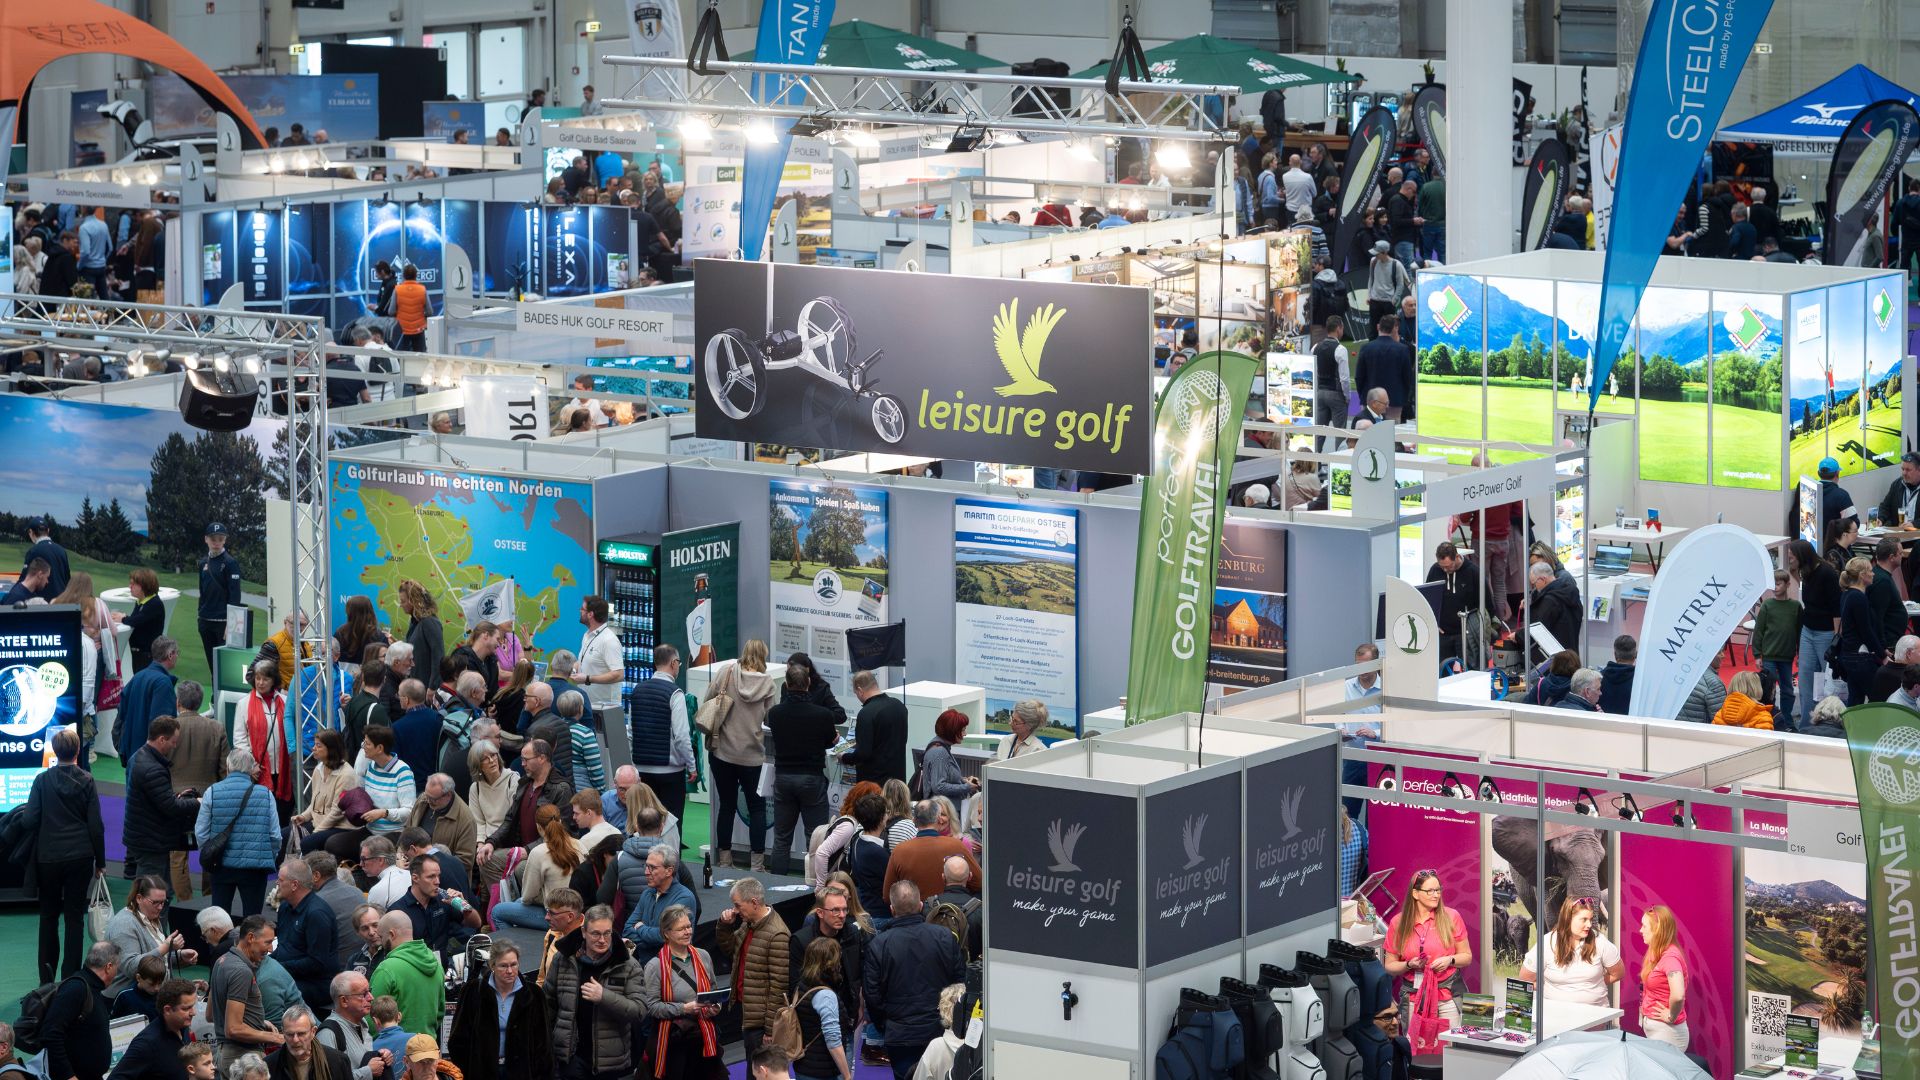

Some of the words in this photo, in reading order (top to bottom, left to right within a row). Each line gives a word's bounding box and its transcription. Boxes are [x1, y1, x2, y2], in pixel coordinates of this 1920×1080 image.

[1724, 29, 1734, 42] by
[1719, 44, 1731, 69] made
[1258, 73, 1312, 86] HOLSTEN
[559, 133, 573, 143] Golf
[576, 135, 592, 145] Club
[594, 135, 608, 145] Bad
[609, 136, 637, 145] Saarow
[794, 147, 820, 156] POLEN
[718, 170, 735, 179] Golf
[1863, 121, 1911, 211] www.private-greens.de
[705, 200, 724, 210] GOLF
[525, 312, 558, 325] BADES
[562, 316, 583, 327] HUK
[587, 317, 616, 330] GOLF
[619, 319, 663, 333] RESORT
[918, 389, 1049, 439] leisure
[1055, 403, 1133, 454] golf
[347, 464, 426, 486] Golfurlaub
[430, 471, 448, 487] im
[452, 475, 504, 493] echten
[509, 480, 563, 499] Norden
[1463, 481, 1504, 501] PG-Power
[1505, 475, 1522, 494] Golf
[775, 493, 810, 504] Ankommen
[815, 497, 839, 507] Spielen
[843, 500, 860, 510] Spaß
[860, 502, 880, 512] haben
[1157, 441, 1186, 566] perfect
[964, 511, 996, 521] MARITIM
[997, 514, 1036, 525] GOLFPARK
[1037, 518, 1067, 529] OSTSEE
[494, 538, 527, 551] OSTSEE
[670, 540, 731, 568] HOLSTEN
[618, 550, 647, 561] HOLSTEN
[1171, 459, 1221, 661] GOLFTRAVEL
[1659, 574, 1728, 663] MATRIX
[30, 635, 62, 646] TIME
[1673, 640, 1704, 686] GOLF
[1706, 577, 1754, 637] REISEN
[26, 650, 68, 658] MESSEPARTY
[40, 674, 65, 685] 18:00
[1207, 670, 1271, 684] el-breitenburg.de
[1750, 821, 1760, 830] La
[1256, 842, 1298, 870] leisure
[1300, 827, 1326, 860] golf
[1790, 844, 1806, 854] C16
[1836, 832, 1862, 847] Golf
[1007, 865, 1076, 895] leisure
[1080, 876, 1122, 906] golf
[1156, 872, 1202, 900] leisure
[1203, 856, 1231, 891] golf
[1259, 872, 1281, 889] make
[1280, 869, 1300, 897] your
[1302, 861, 1324, 884] game
[1013, 898, 1047, 912] make
[1044, 904, 1078, 928] your
[1080, 908, 1116, 928] game
[1160, 904, 1182, 920] make
[1182, 898, 1203, 928] your
[1203, 891, 1227, 917] game
[1751, 1051, 1764, 1060] mit
